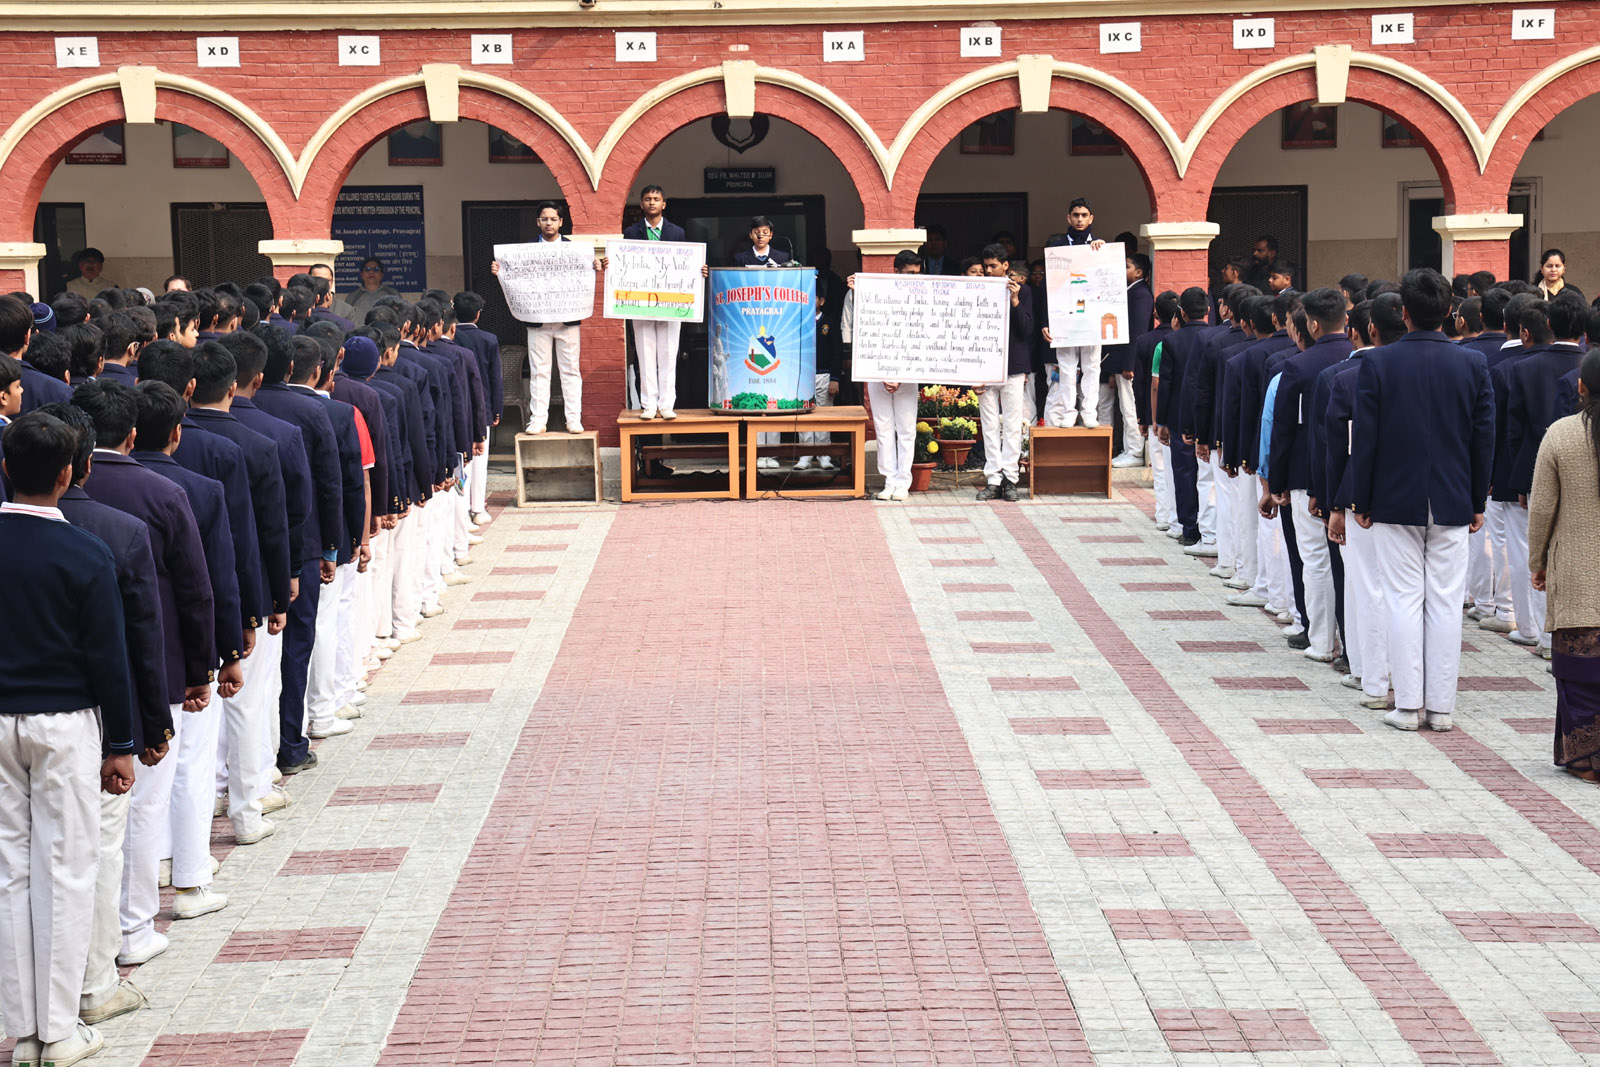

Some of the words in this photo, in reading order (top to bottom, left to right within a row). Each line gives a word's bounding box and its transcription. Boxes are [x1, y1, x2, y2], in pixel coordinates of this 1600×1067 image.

[1381, 24, 1393, 33] IX
[1397, 24, 1405, 33] E
[1521, 19, 1533, 28] IX
[1538, 19, 1545, 28] F
[1108, 32, 1120, 41] IX
[1124, 32, 1133, 41] C
[1241, 28, 1253, 38] IX
[1258, 28, 1266, 37] D
[831, 41, 843, 50] IX
[847, 41, 856, 50] A
[969, 36, 981, 46] IX
[985, 36, 993, 46] B
[67, 47, 75, 56] X
[79, 47, 87, 56] E
[207, 47, 216, 56] X
[220, 47, 229, 56] D
[348, 45, 357, 55] X
[361, 45, 369, 55] C
[481, 44, 490, 53] X
[494, 44, 502, 53] B
[626, 42, 634, 51] X
[638, 42, 647, 51] A
[616, 254, 630, 276] My
[655, 256, 671, 279] My
[672, 256, 690, 270] Vote
[610, 274, 639, 290] Citizen
[641, 278, 648, 288] at
[651, 274, 661, 290] the
[664, 274, 685, 293] heart
[687, 278, 696, 290] of
[716, 292, 725, 305] ST.
[726, 286, 772, 304] JOSEPH'S
[774, 286, 809, 305] COLLEGE
[615, 290, 640, 308] Indian
[648, 292, 695, 317] Democracy
[884, 295, 901, 304] citizens
[904, 295, 911, 304] of
[933, 296, 949, 308] having
[954, 296, 972, 311] abiding
[977, 296, 989, 307] faith
[741, 307, 782, 315] PRAYAGRAJ
[891, 306, 907, 320] hereby
[910, 307, 924, 320] pledge
[931, 308, 937, 316] to
[940, 308, 956, 322] uphold
[962, 308, 970, 318] the
[977, 308, 1002, 319] democratic
[905, 319, 924, 332] country
[977, 320, 984, 330] of
[859, 328, 868, 336] fair
[870, 328, 880, 337] and
[936, 330, 946, 339] and
[952, 331, 958, 340] to
[960, 332, 970, 340] vote
[859, 339, 877, 348] election
[882, 340, 907, 352] fearlessly
[911, 340, 921, 350] and
[926, 341, 947, 350] without
[950, 341, 964, 356] being
[968, 342, 993, 352] influenced
[995, 343, 1003, 356] by
[894, 351, 900, 360] of
[915, 367, 925, 376] any
